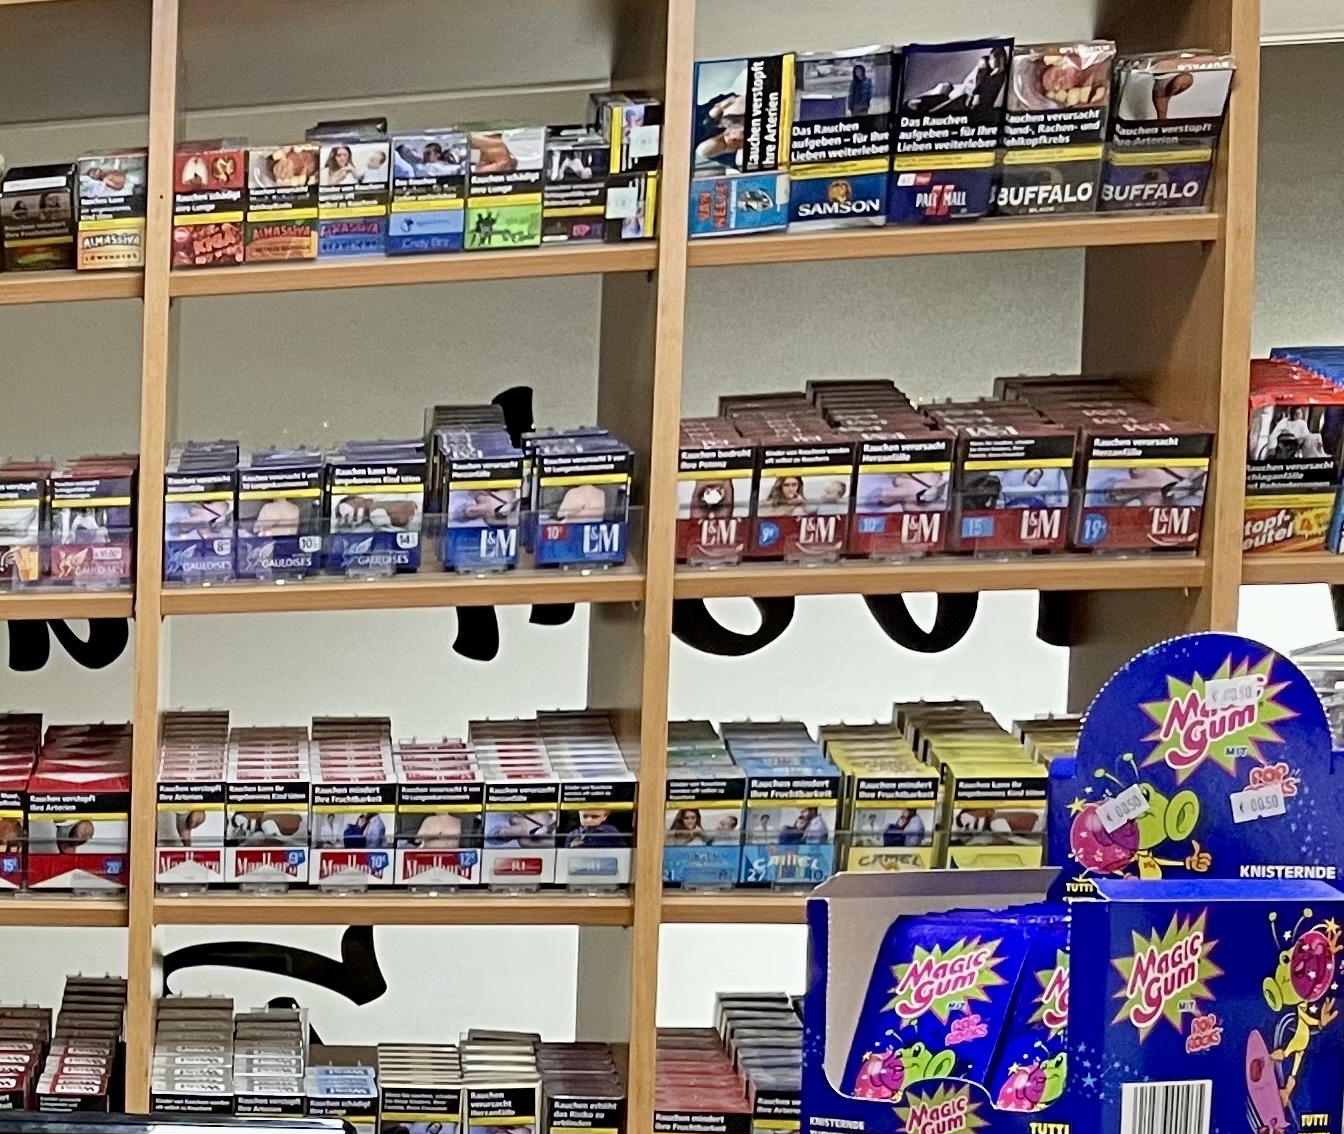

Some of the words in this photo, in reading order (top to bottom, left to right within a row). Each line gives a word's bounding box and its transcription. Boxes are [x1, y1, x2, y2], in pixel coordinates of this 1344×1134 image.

[792, 125, 811, 136] Das
[814, 121, 859, 135] Rauchen
[901, 116, 920, 128] Das
[922, 115, 967, 127] Rauchen
[1081, 121, 1100, 131] und
[899, 128, 948, 141] aufgeben
[792, 136, 841, 150] aufgeben
[897, 141, 932, 154] Lieben
[791, 149, 826, 162] Lieben
[998, 182, 1093, 206] BUFFALO
[1102, 181, 1198, 201] BUFFALO
[798, 199, 880, 217] SAMSON
[901, 513, 940, 544] L&M
[1020, 509, 1061, 540] L&M
[1244, 510, 1290, 537] topf-
[480, 529, 517, 558] L&M
[583, 525, 619, 553] L&M
[1243, 526, 1293, 550] eutel
[1240, 865, 1336, 880] KNISTERNDE
[1066, 883, 1093, 892] TUTTI
